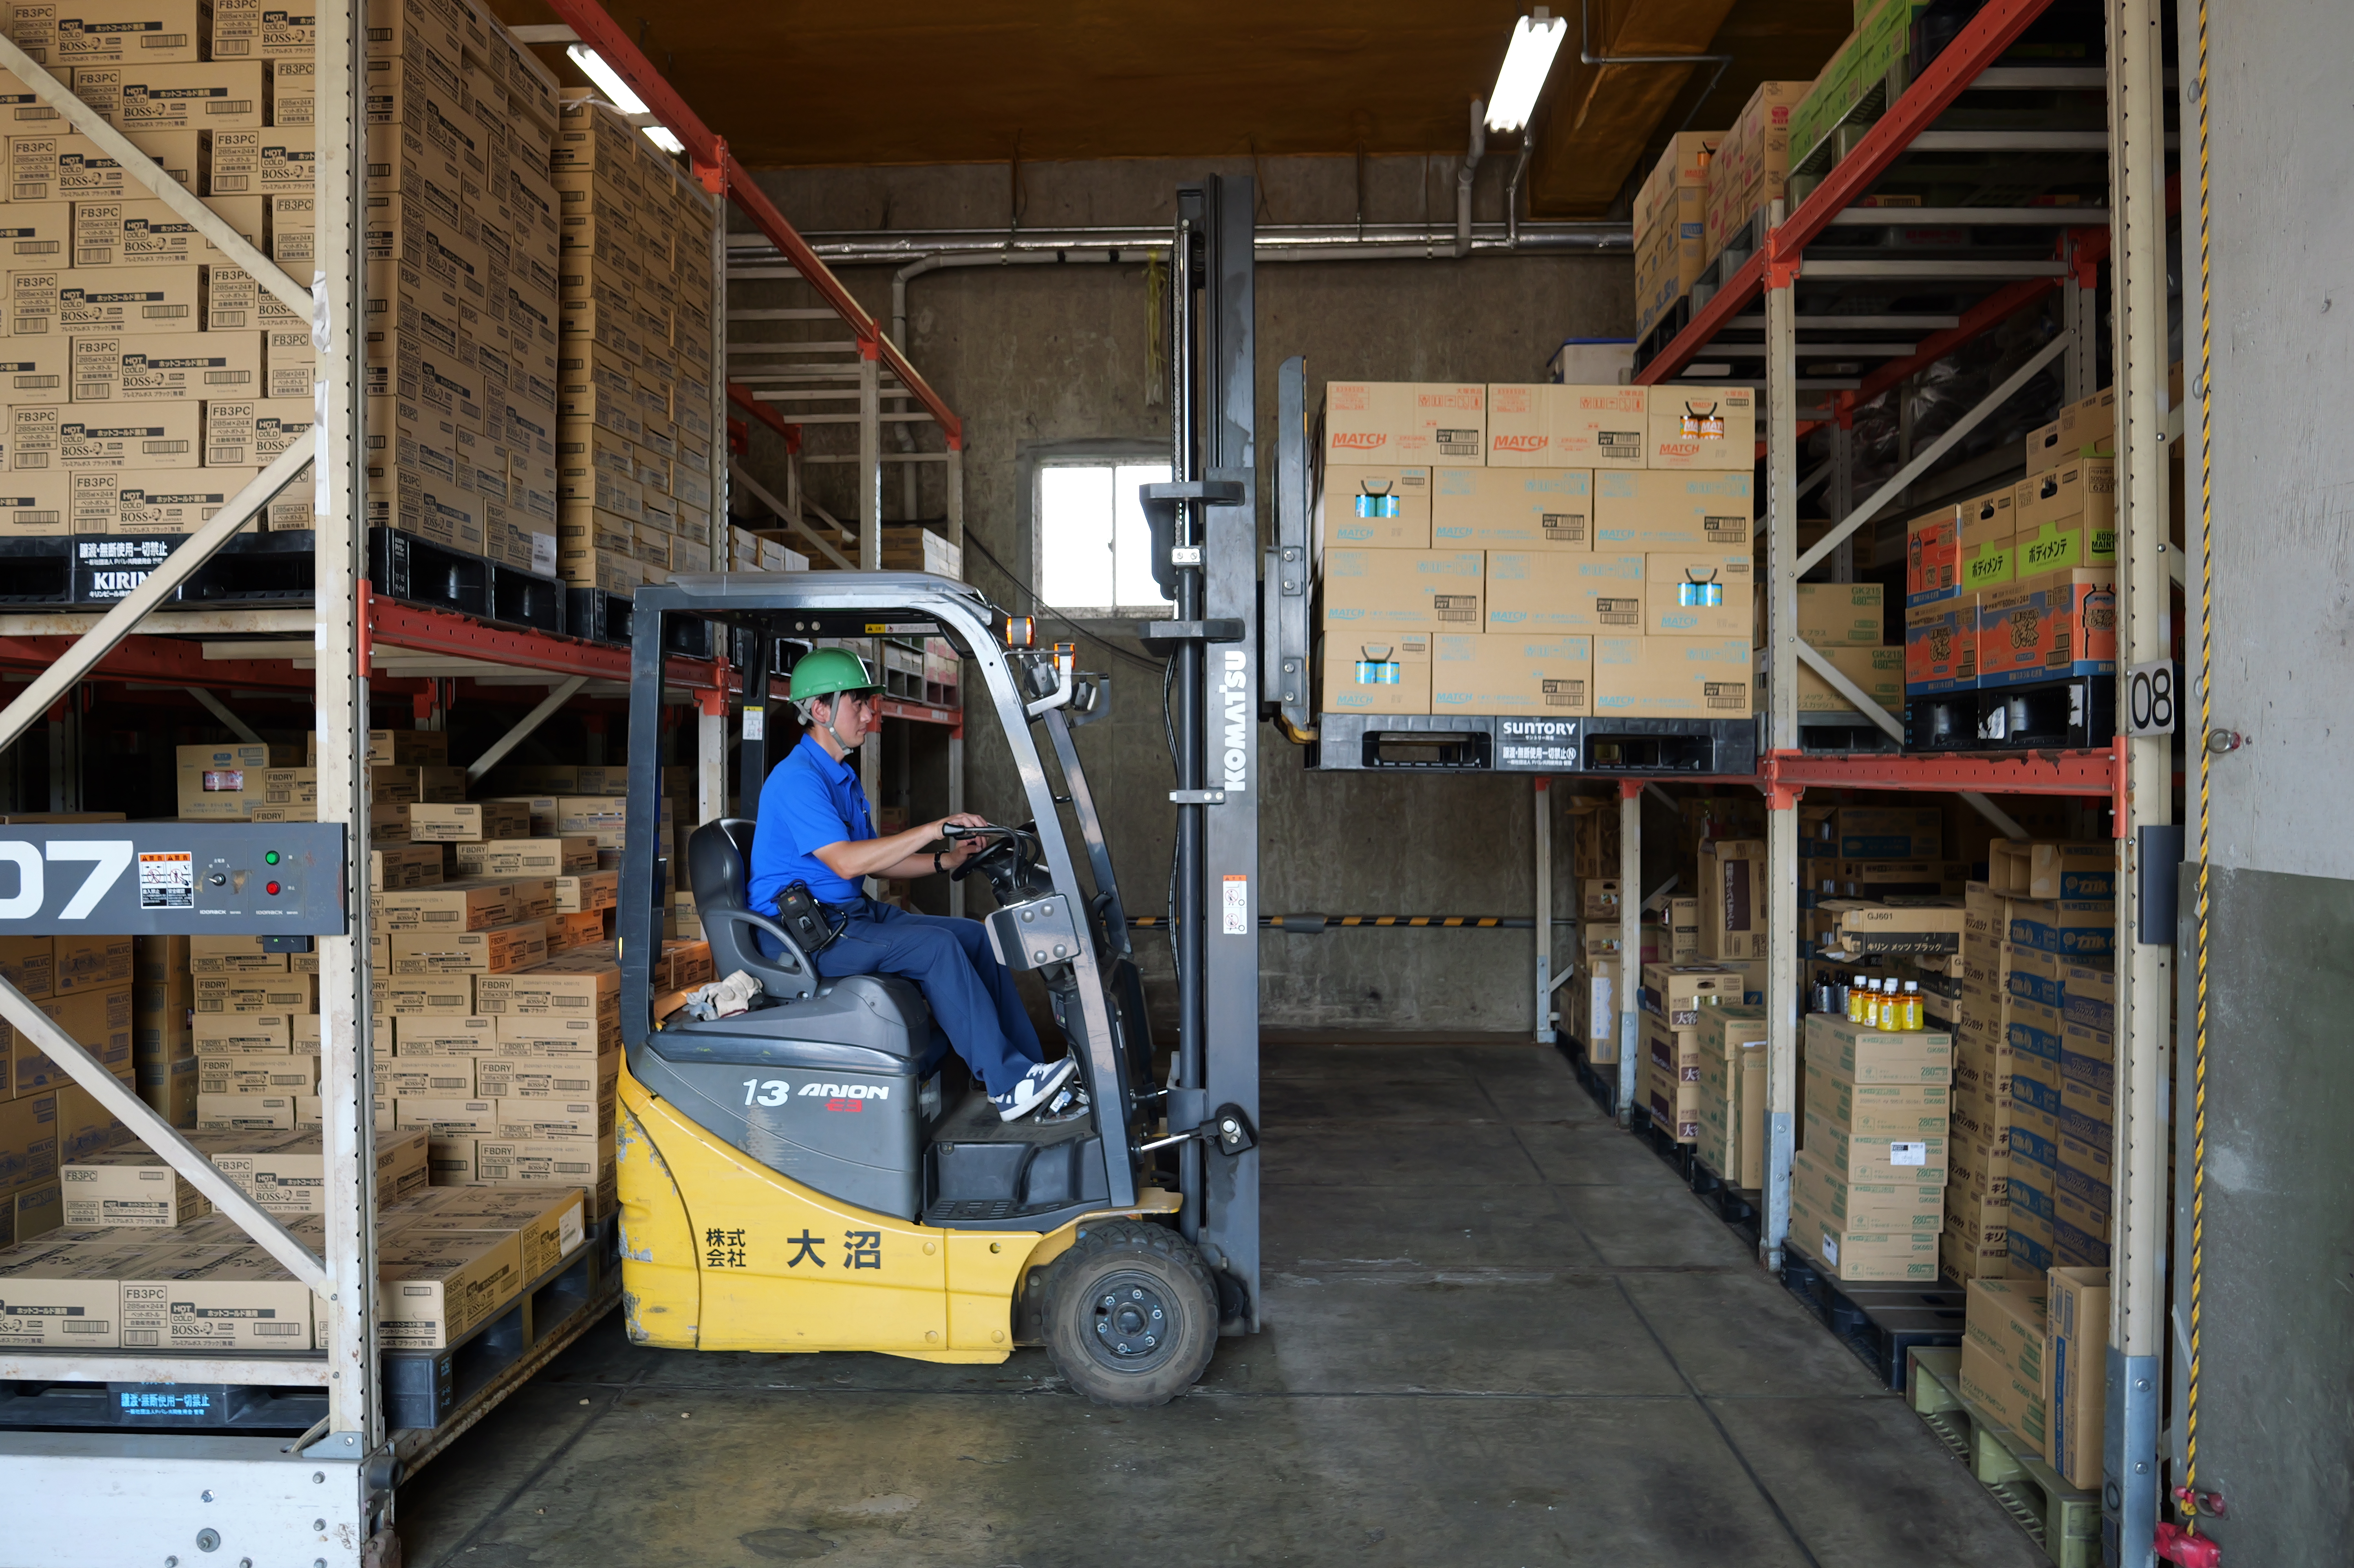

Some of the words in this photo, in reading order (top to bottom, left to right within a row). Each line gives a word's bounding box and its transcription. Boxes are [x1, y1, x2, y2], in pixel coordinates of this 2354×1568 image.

[219, 0, 256, 9] FB3PC
[15, 8, 53, 18] FB3PC
[263, 33, 291, 43] BOSS
[60, 42, 88, 51] BOSS
[280, 64, 312, 74] FB3PC
[80, 73, 117, 83] FB3PC
[124, 107, 151, 117] BOSS
[218, 135, 256, 144] FB3PC
[16, 143, 53, 152] FB3PC
[262, 169, 290, 178] BOSS
[60, 176, 88, 186] BOSS
[278, 200, 311, 209] FB3PC
[81, 208, 118, 217] FB3PC
[404, 203, 424, 224] FB3PC
[125, 241, 152, 251] BOSS
[215, 271, 252, 280] FB3PC
[17, 277, 54, 286] FB3PC
[259, 305, 286, 315] BOSS
[61, 311, 89, 321] BOSS
[274, 335, 306, 345] FB3PC
[79, 343, 116, 352] FB3PC
[399, 338, 420, 355] FB3PC
[123, 377, 150, 386] BOSS
[213, 406, 250, 416] FB3PC
[18, 412, 55, 421] FB3PC
[256, 440, 284, 451] BOSS
[1332, 433, 1387, 448] MATCH
[1493, 436, 1549, 451] MATCH
[61, 446, 89, 456] BOSS
[1660, 444, 1700, 455] MATCH
[77, 478, 115, 487] FB3PC
[399, 473, 420, 487] FB3PC
[120, 512, 148, 522] BOSS
[1337, 529, 1373, 539] MATCH
[1436, 528, 1473, 537] MATCH
[1598, 529, 1635, 540] MATCH
[2029, 538, 2067, 564] ボディメンテ
[1972, 555, 2003, 578] ボディメンテ
[1328, 609, 1365, 619] MATCH
[1491, 611, 1527, 621] MATCH
[1661, 617, 1698, 628] MATCH
[1337, 696, 1373, 705] MATCH
[1436, 693, 1473, 702] MATCH
[1598, 696, 1635, 706] MATCH
[2131, 667, 2172, 729] 08
[1224, 651, 1247, 791] KOMATSU
[1503, 722, 1576, 735] SUNTORY
[1867, 943, 1889, 951] キリン
[1891, 943, 1911, 952] メッツ
[1914, 943, 1942, 952] ブラック
[203, 1061, 231, 1070] FBDRY
[483, 1063, 511, 1072] FBDRY
[743, 1078, 790, 1106] 13
[798, 1083, 889, 1099] ARION
[484, 1147, 512, 1155] FBDRY
[256, 1192, 280, 1201] BOSS
[706, 1228, 746, 1248] 株式
[706, 1249, 746, 1268] 会社
[126, 1290, 164, 1299] FB3PC
[171, 1326, 199, 1335] BOSS
